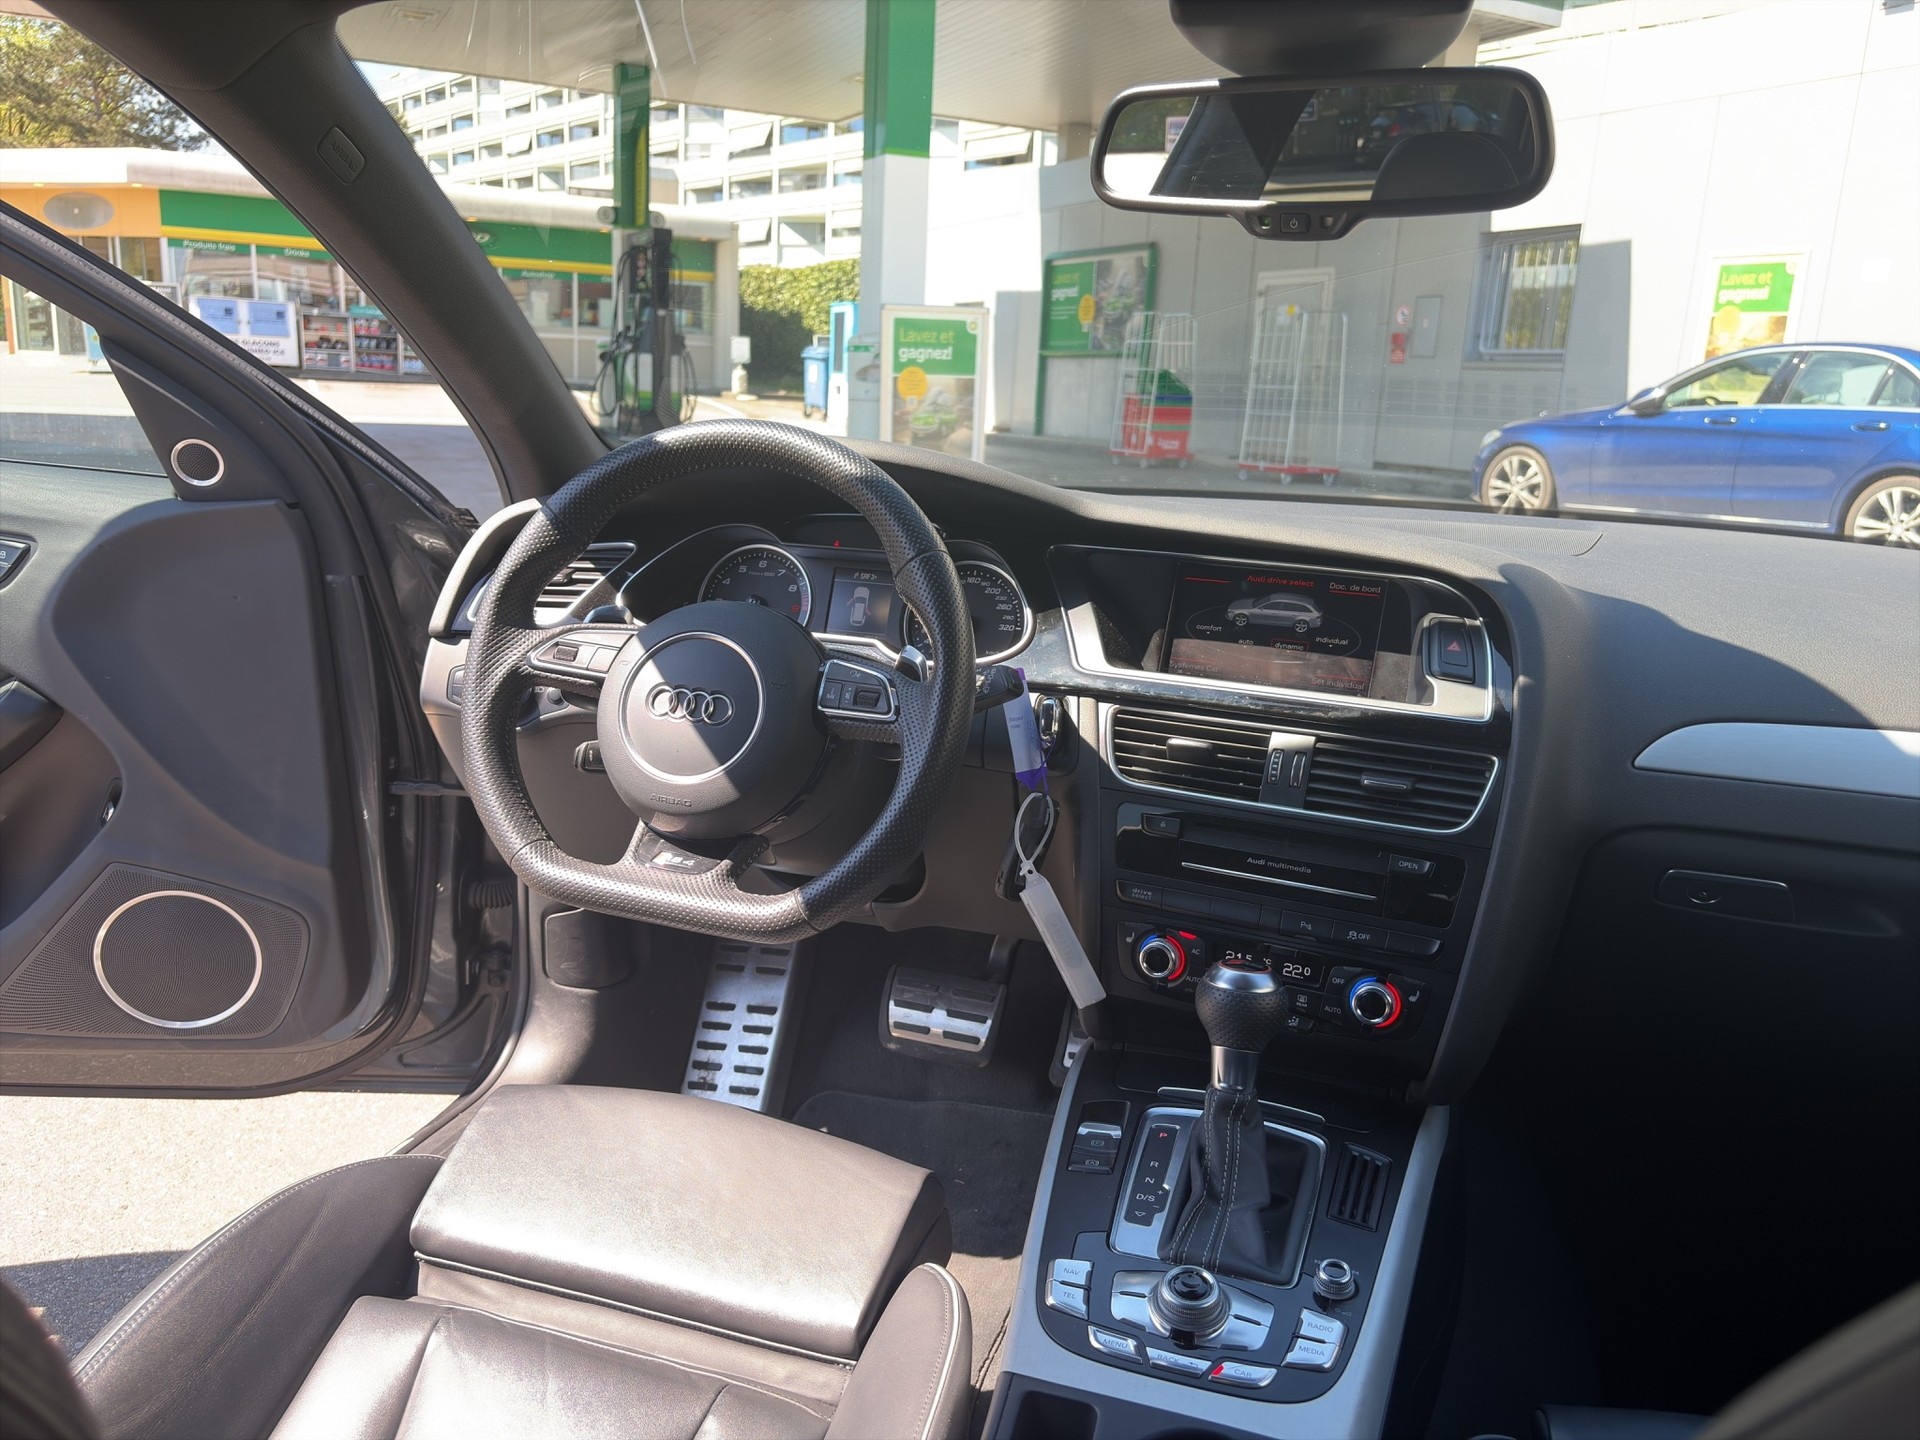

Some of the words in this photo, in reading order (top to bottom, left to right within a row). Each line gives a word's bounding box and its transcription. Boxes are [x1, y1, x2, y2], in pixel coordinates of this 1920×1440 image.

[1721, 271, 1757, 286] Lavez
[1758, 270, 1774, 285] et
[899, 327, 938, 342] Lavez
[939, 331, 956, 343] et
[898, 346, 953, 362] gagnez!
[758, 560, 768, 568] 6
[738, 565, 747, 573] 5
[777, 569, 786, 577] 7
[722, 577, 731, 585] 4
[1247, 575, 1266, 583] Audi
[1267, 577, 1288, 585] drive
[1289, 579, 1315, 587] select
[788, 584, 797, 592] 8
[984, 587, 1001, 595] 200
[1329, 582, 1347, 590] Doc.
[1349, 584, 1360, 592] de
[1361, 585, 1381, 593] bord
[996, 603, 1012, 611] 260
[998, 624, 1015, 632] 320
[1196, 624, 1222, 632] comfort
[1315, 636, 1349, 645] individual
[1274, 642, 1304, 652] dynamic
[650, 793, 692, 808] AIRBAG
[1246, 857, 1265, 866] Audi
[1267, 860, 1312, 874] multimedia
[1398, 860, 1418, 870] OPEN
[1358, 932, 1371, 940] OFF
[1332, 976, 1345, 985] OFF
[1324, 1005, 1342, 1014] AUTO
[1150, 1160, 1159, 1168] R
[1144, 1176, 1155, 1184] N
[1136, 1193, 1155, 1202] D/S
[1063, 1267, 1080, 1276] NAV
[1063, 1291, 1076, 1300] TEL
[1307, 1321, 1334, 1333] RADIO
[1102, 1338, 1128, 1349] MENU
[1298, 1345, 1325, 1357] MEDIA
[1156, 1353, 1180, 1363] BACK
[1234, 1368, 1252, 1378] CAR
